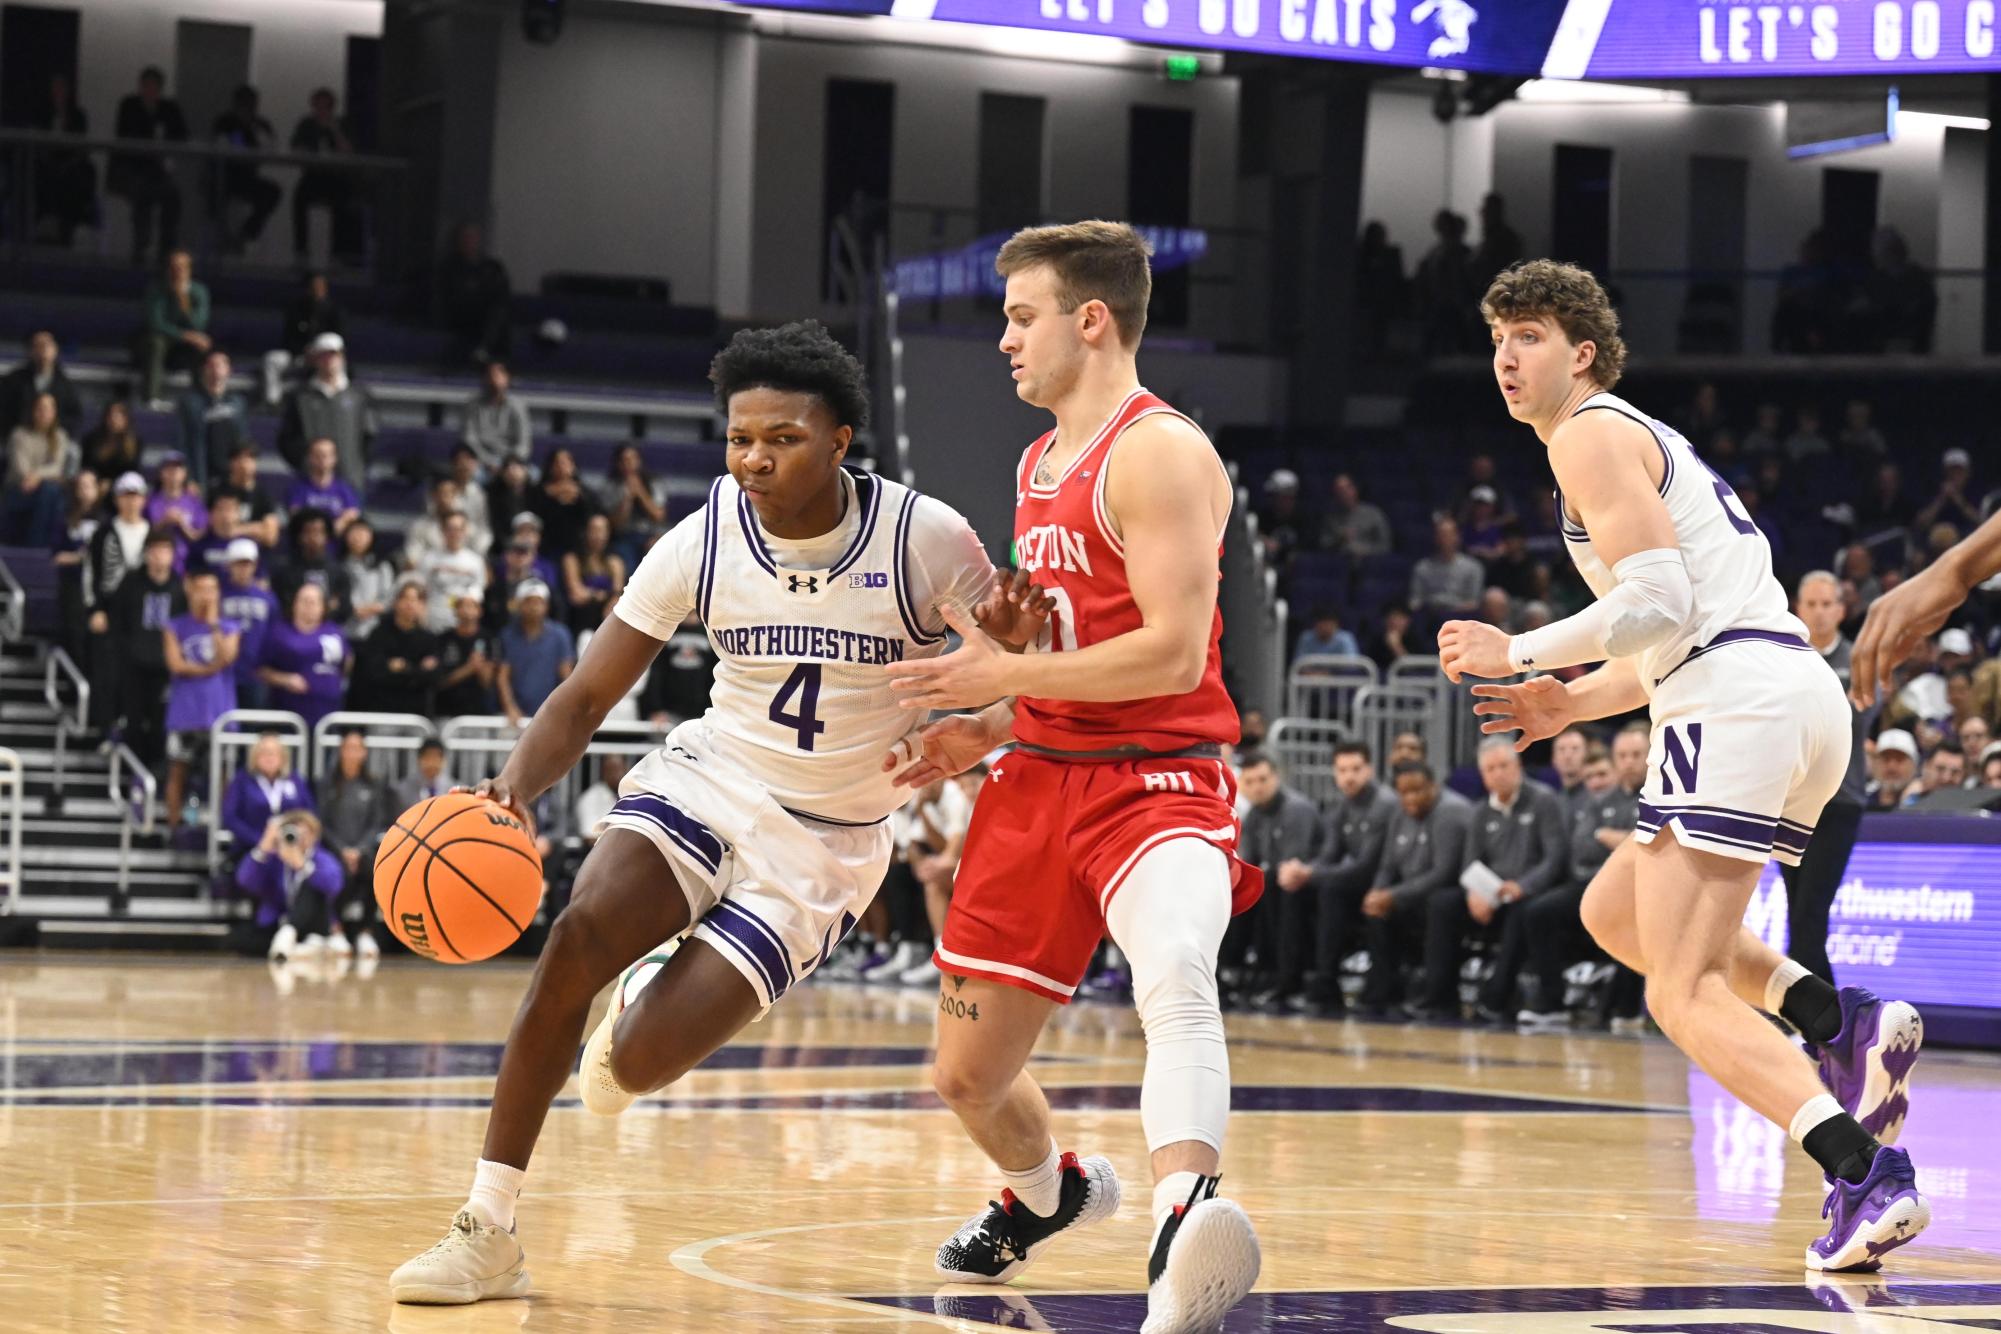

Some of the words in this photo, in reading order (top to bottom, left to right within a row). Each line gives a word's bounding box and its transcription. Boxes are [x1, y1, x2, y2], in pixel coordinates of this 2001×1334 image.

[1280, 0, 1396, 51] CATS
[1699, 5, 1839, 63] LET'S
[1872, 1, 1941, 60] GO
[711, 624, 905, 666] NORTHWESTERN
[768, 662, 825, 752] 4
[1660, 722, 1702, 795] N
[940, 991, 980, 1021] 2004
